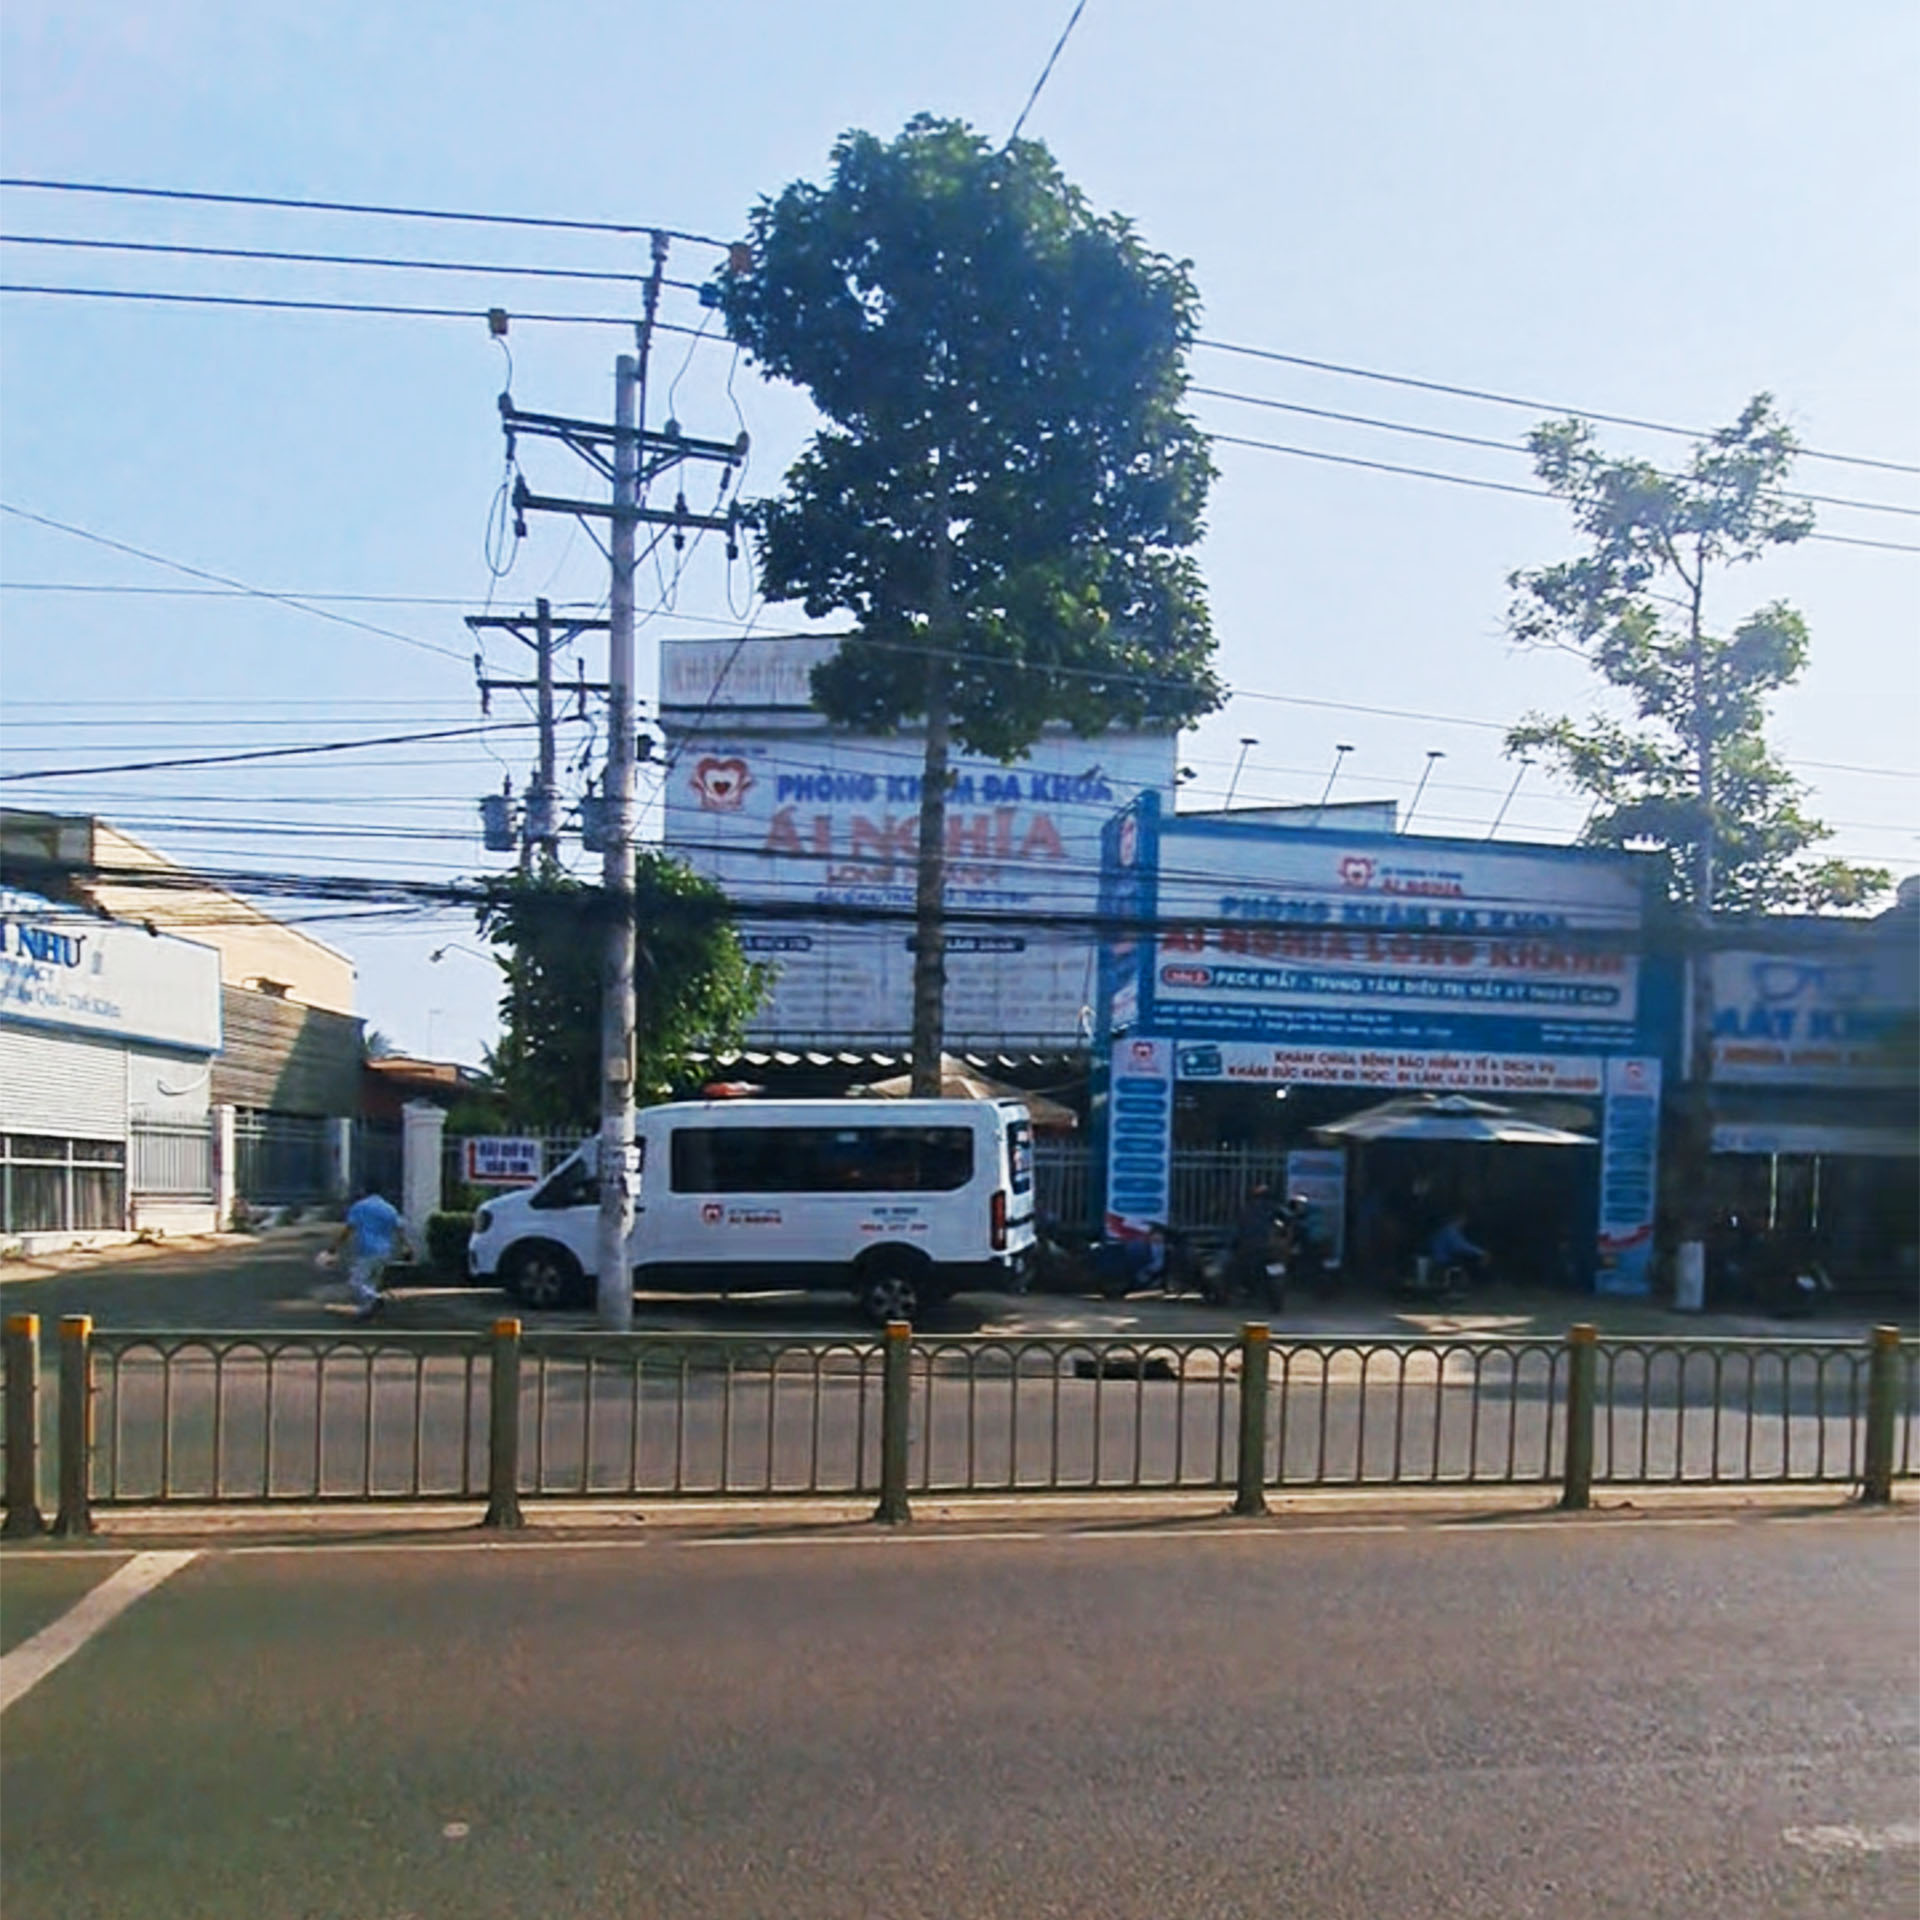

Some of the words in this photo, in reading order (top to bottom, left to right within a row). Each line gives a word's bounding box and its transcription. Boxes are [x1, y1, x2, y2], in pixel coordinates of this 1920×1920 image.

[886, 774, 975, 804] KHM
[765, 804, 833, 859] ÁI
[16, 922, 87, 968] NHƯ
